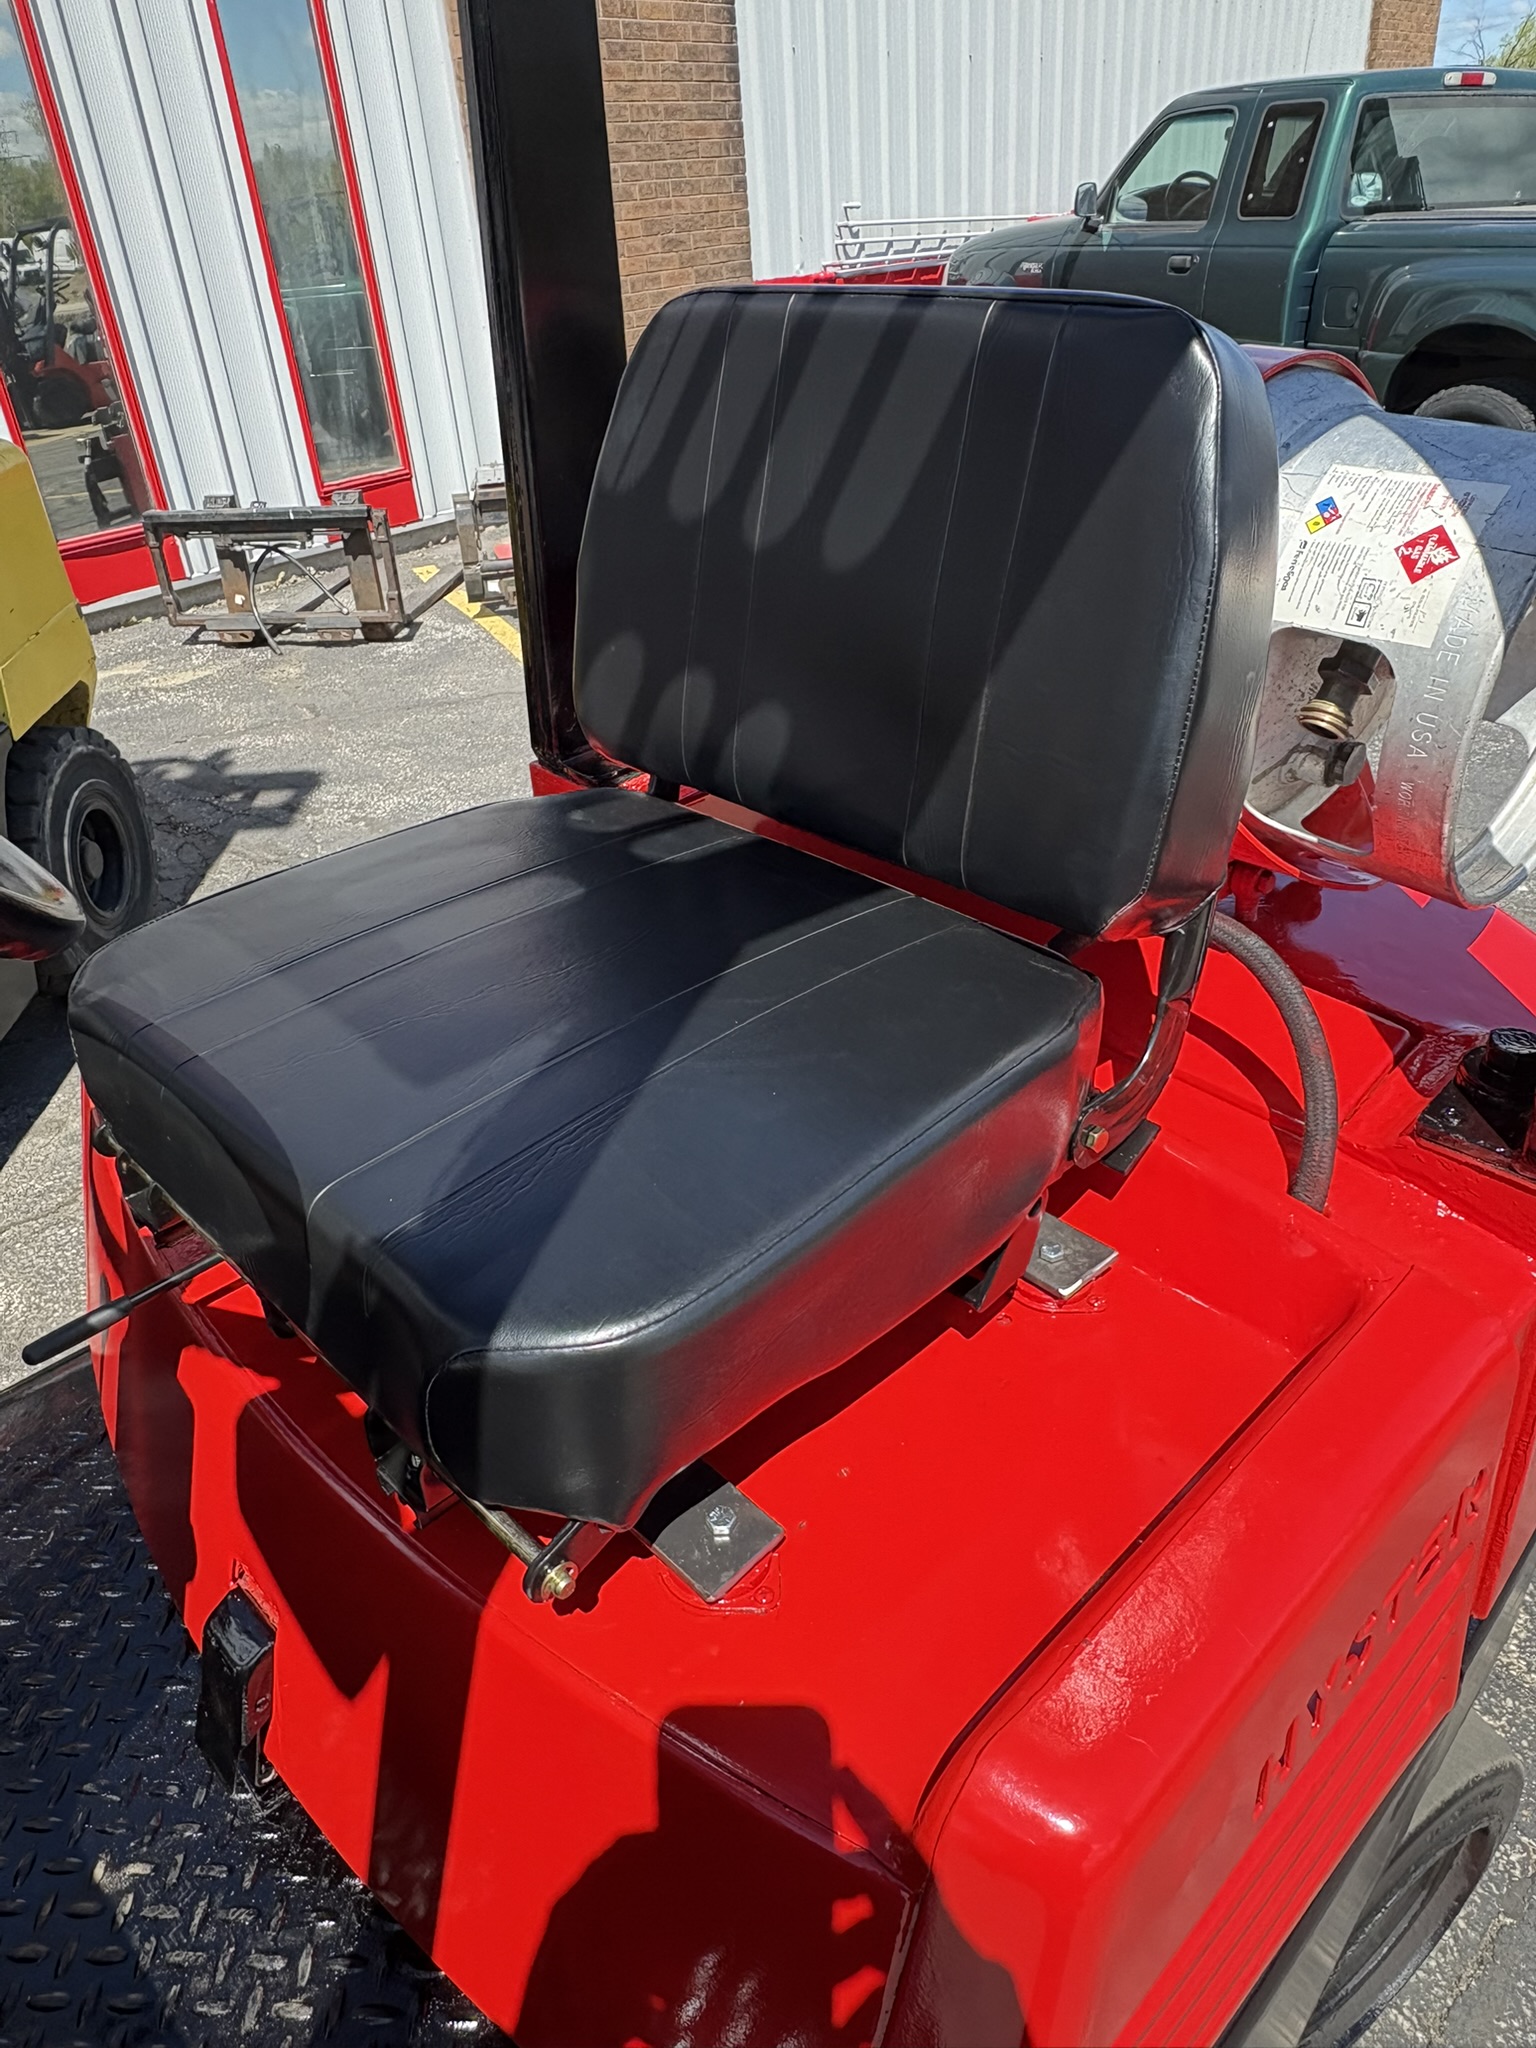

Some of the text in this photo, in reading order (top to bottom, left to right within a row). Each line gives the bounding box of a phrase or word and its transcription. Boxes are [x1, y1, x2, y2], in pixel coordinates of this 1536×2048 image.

[1406, 592, 1480, 758] MADE IN USA
